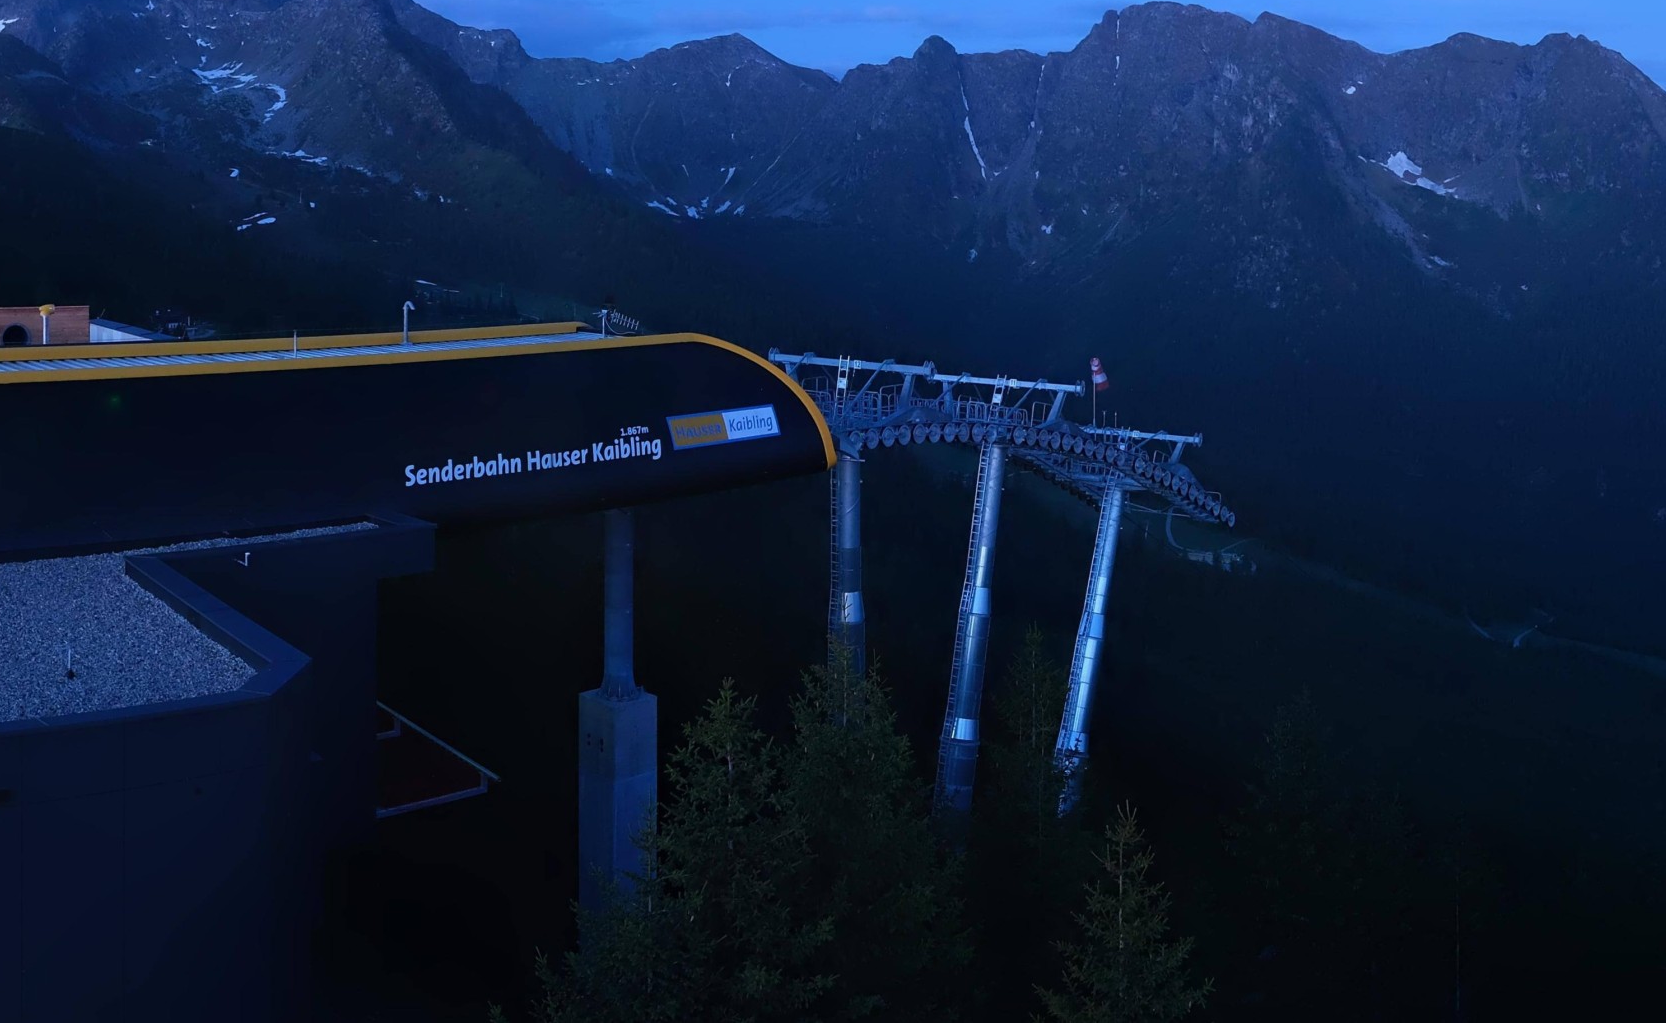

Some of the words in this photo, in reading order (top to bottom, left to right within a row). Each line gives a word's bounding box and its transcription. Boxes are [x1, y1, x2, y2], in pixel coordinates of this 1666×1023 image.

[620, 426, 649, 437] 1.867m
[728, 416, 773, 432] Kaibling
[404, 452, 521, 486] Senderbahn
[526, 448, 588, 472] Hauser
[592, 435, 662, 462] Kaibling
